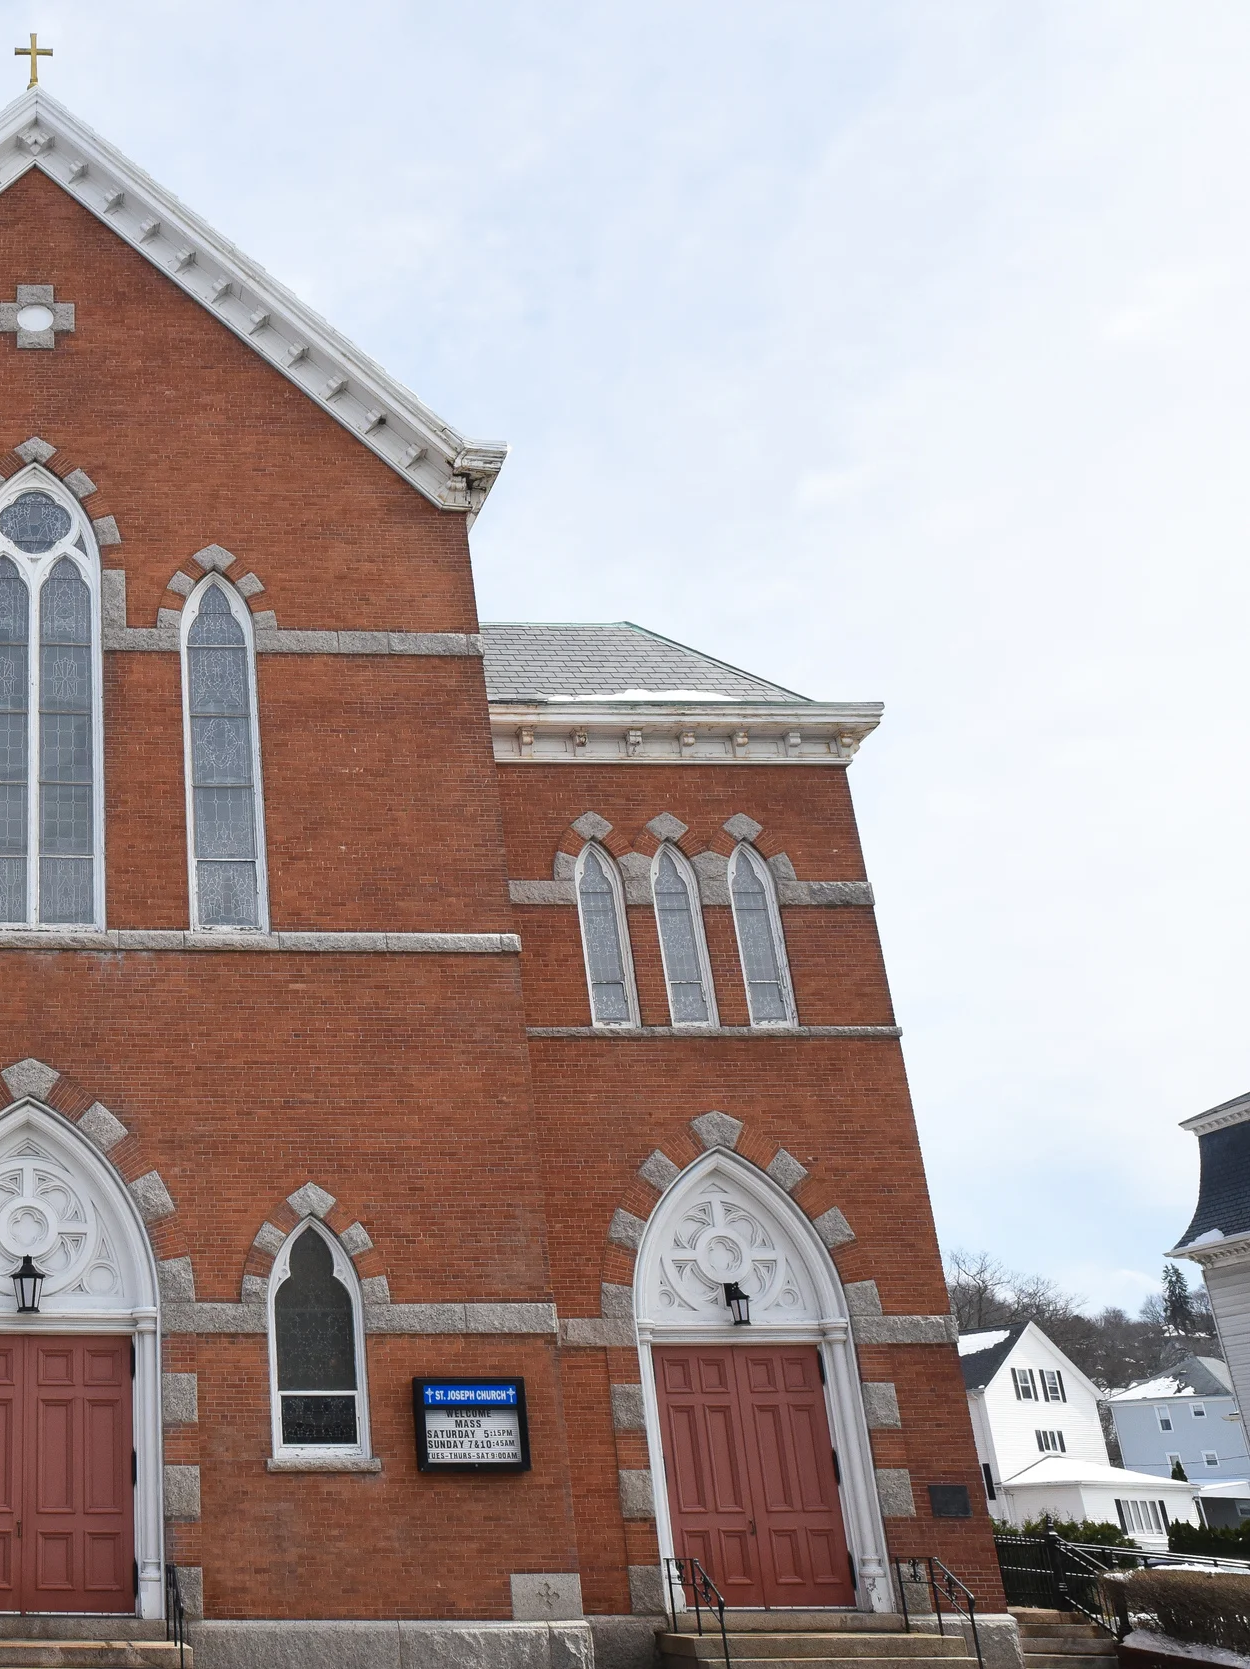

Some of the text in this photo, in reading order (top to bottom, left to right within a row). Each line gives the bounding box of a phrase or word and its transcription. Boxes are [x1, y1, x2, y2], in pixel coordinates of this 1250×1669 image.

[435, 1390, 506, 1400] ST. JOSEPH CHURCH
[446, 1410, 492, 1418] WELCOME
[455, 1419, 482, 1428] MASS
[427, 1429, 513, 1439] SATURDAY 5:15PM
[428, 1440, 465, 1449] SUNDAY
